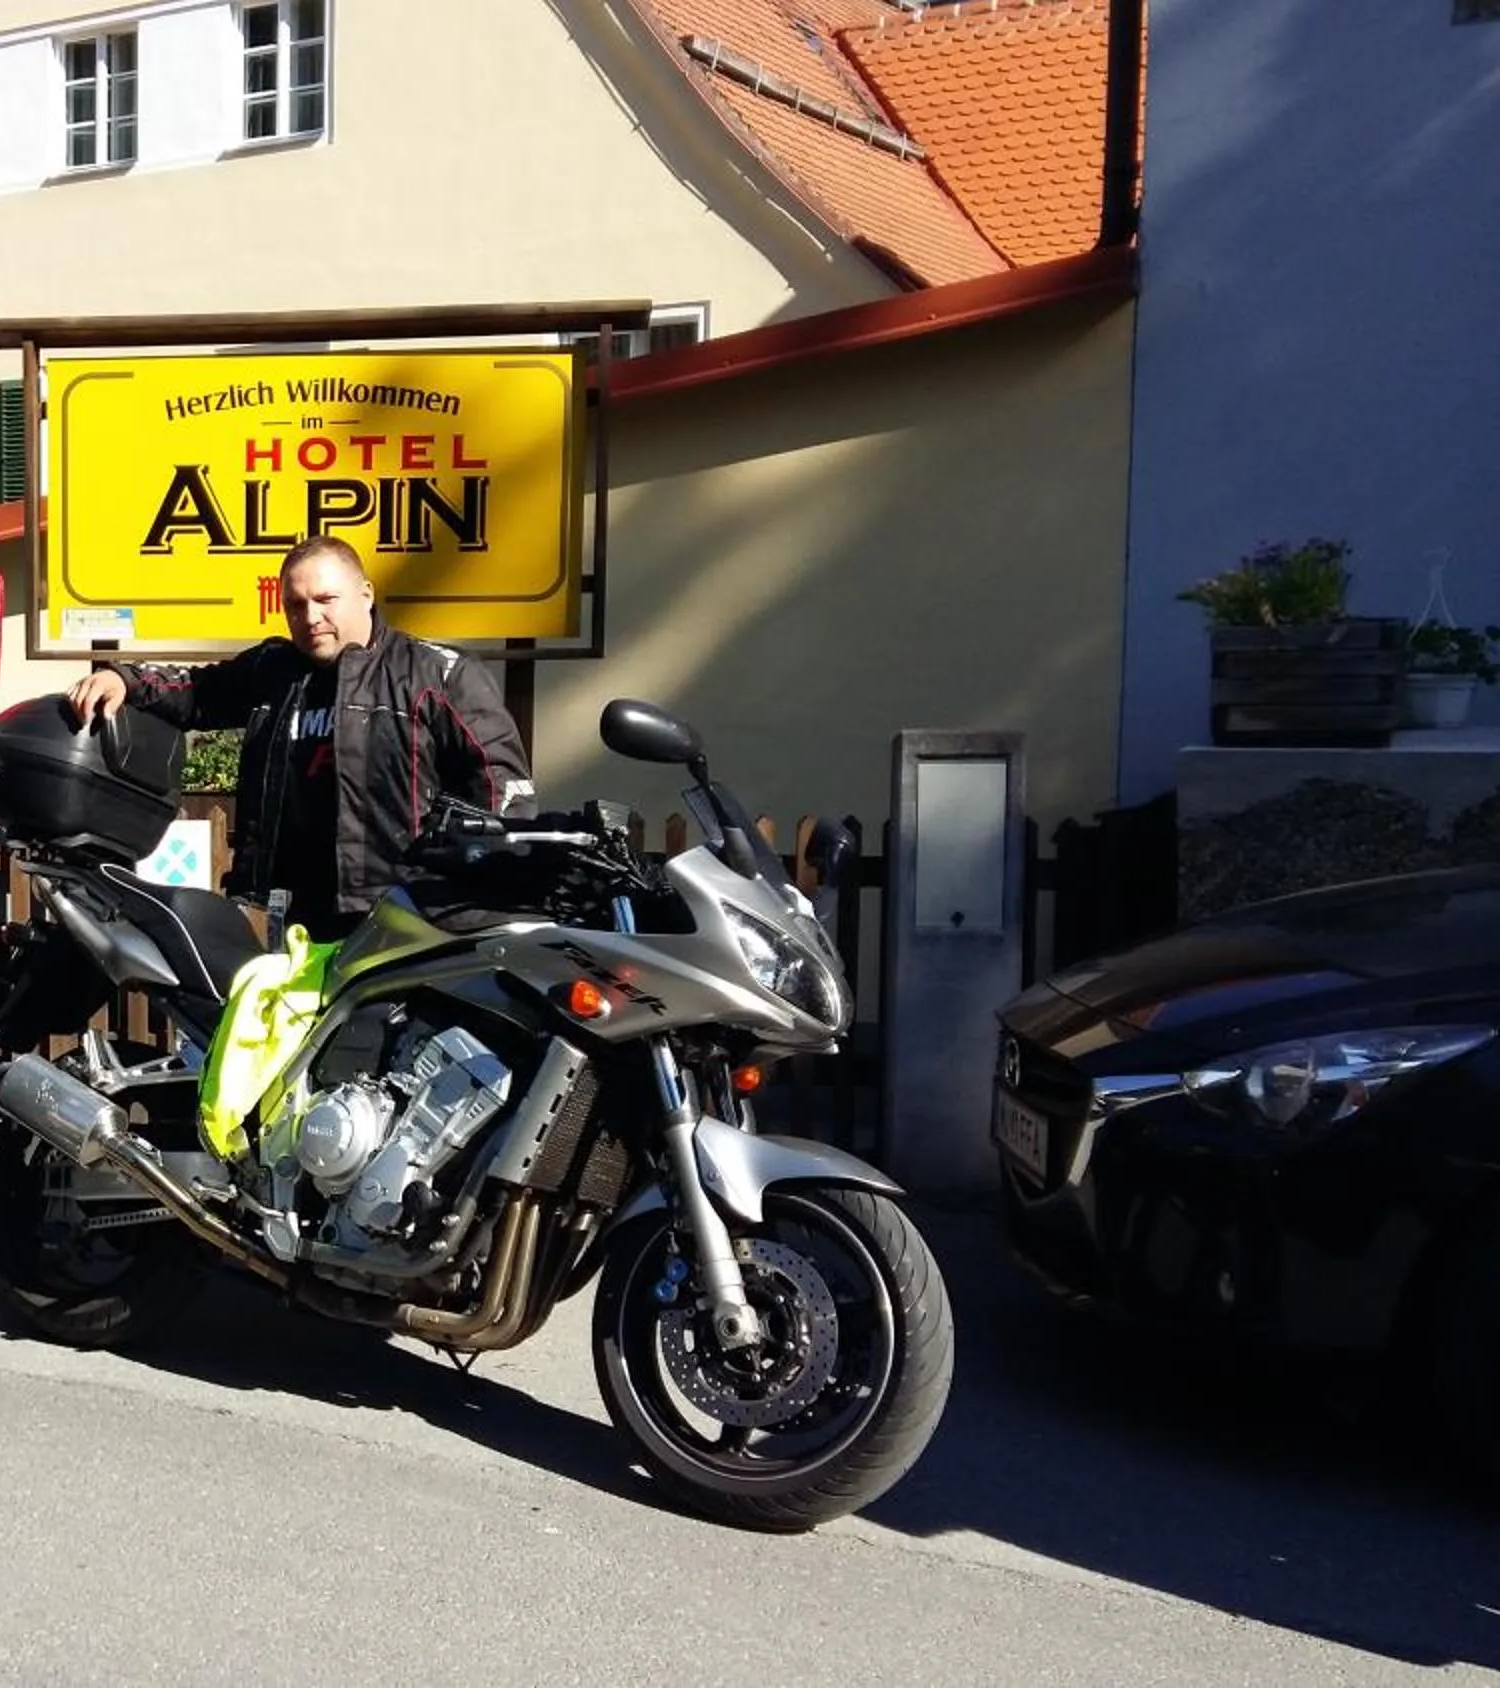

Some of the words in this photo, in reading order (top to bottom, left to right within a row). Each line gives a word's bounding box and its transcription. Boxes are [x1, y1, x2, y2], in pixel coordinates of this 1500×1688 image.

[164, 380, 274, 421] Herzlich
[286, 377, 462, 416] Willkommen
[300, 414, 324, 429] im
[245, 433, 488, 473] HOTEL
[139, 464, 490, 556] ALPIN
